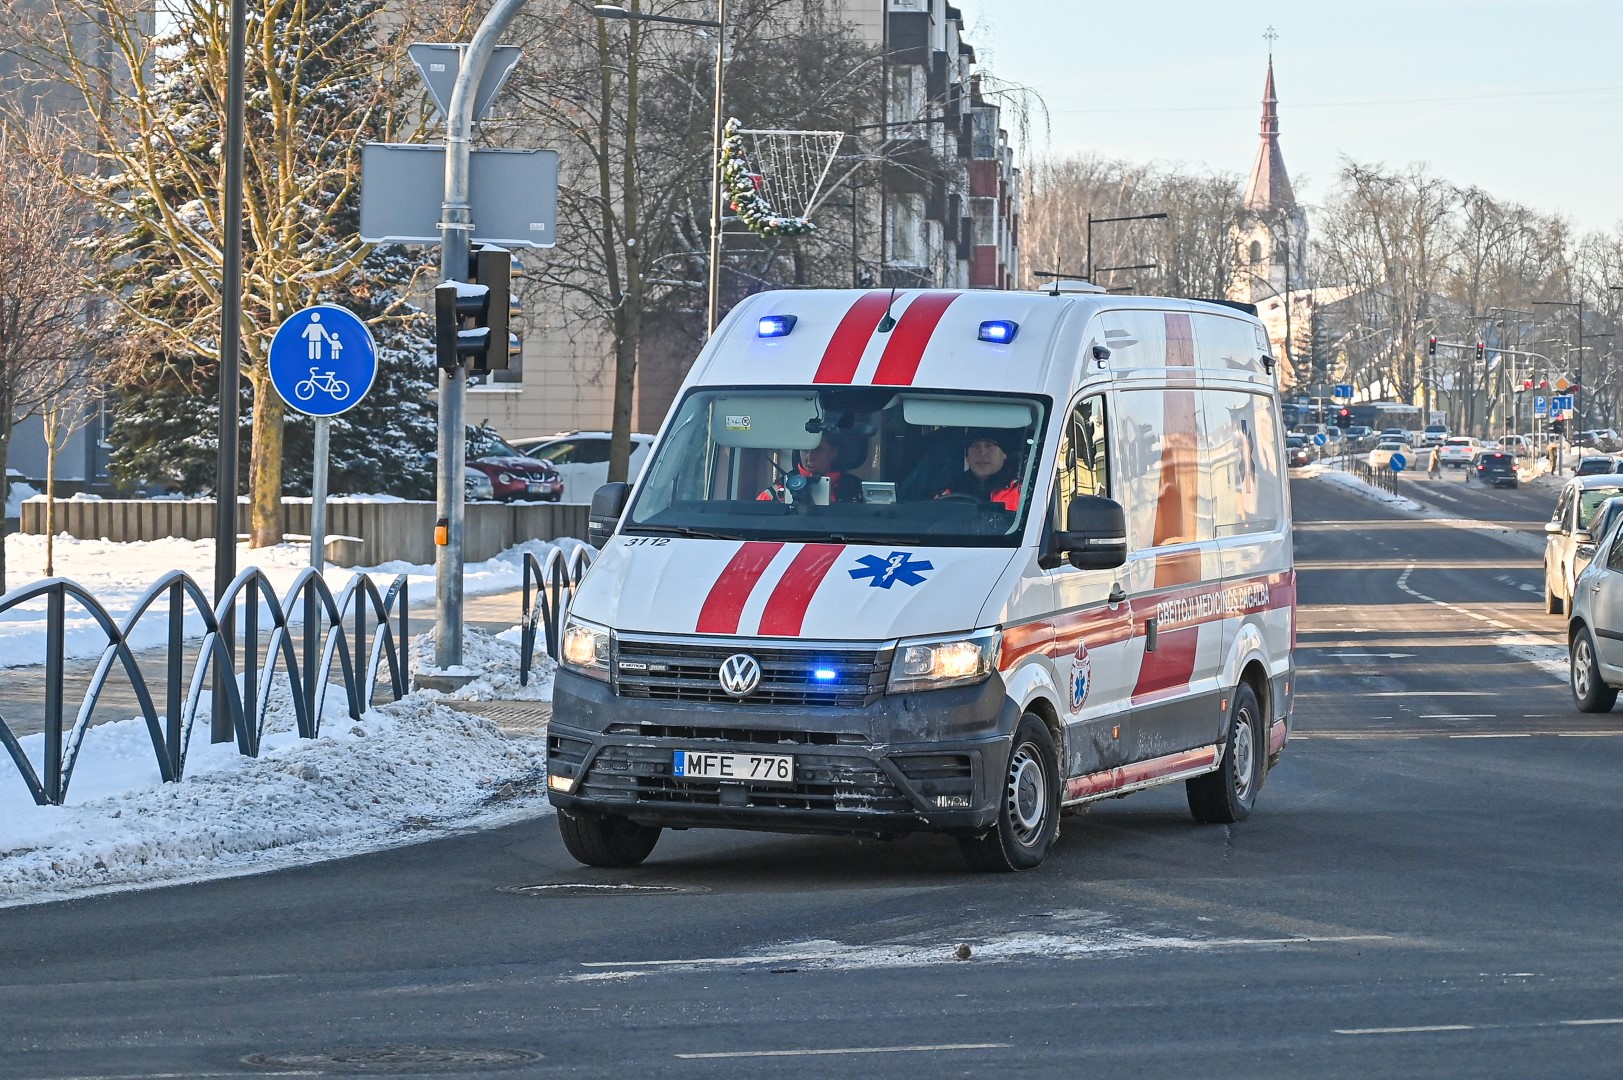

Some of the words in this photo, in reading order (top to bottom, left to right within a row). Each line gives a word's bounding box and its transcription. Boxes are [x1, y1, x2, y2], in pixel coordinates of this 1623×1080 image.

[623, 537, 671, 547] 3112
[1156, 599, 1194, 627] GREITOJI
[1195, 589, 1238, 618] MEDICINOS
[1238, 583, 1270, 610] PAGALBA
[687, 754, 735, 777] MFE
[750, 757, 789, 779] 776
